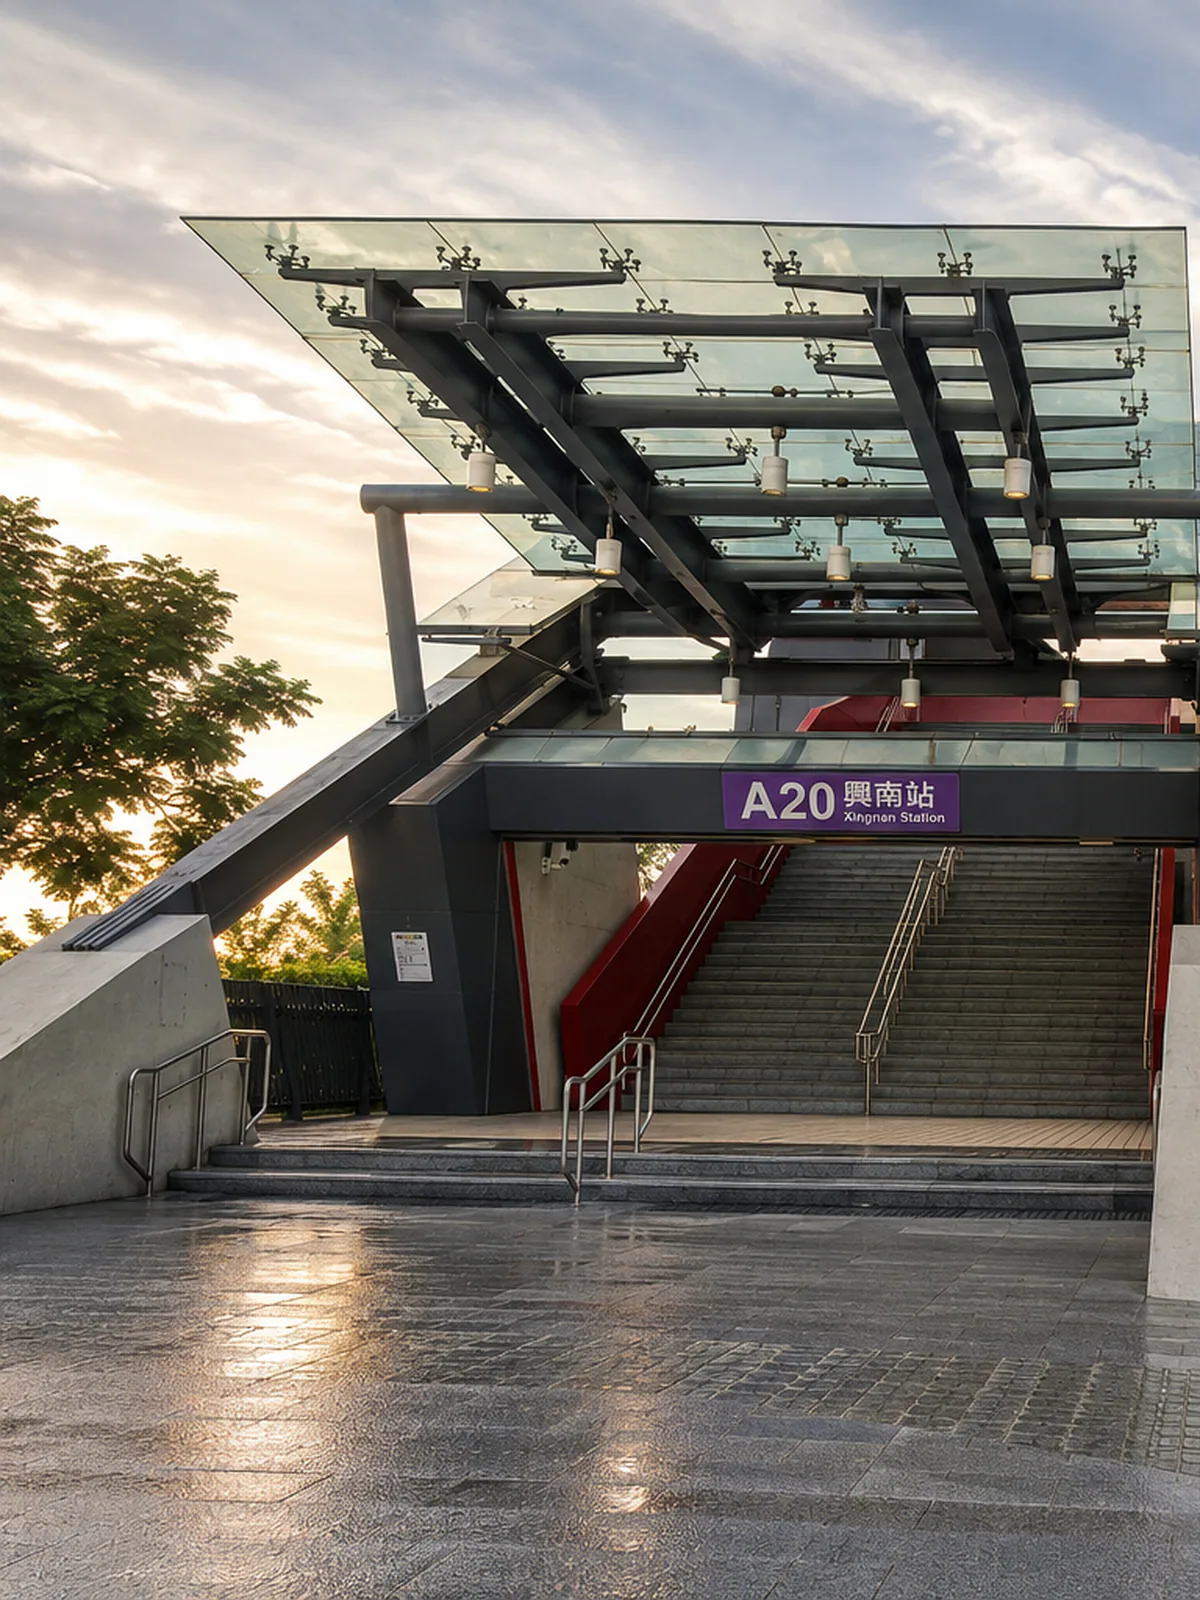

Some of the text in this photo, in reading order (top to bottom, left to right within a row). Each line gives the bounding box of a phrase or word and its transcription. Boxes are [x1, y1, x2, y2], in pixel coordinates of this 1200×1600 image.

[741, 781, 836, 821] A20
[843, 780, 934, 809] 興南站
[900, 811, 945, 823] Station
